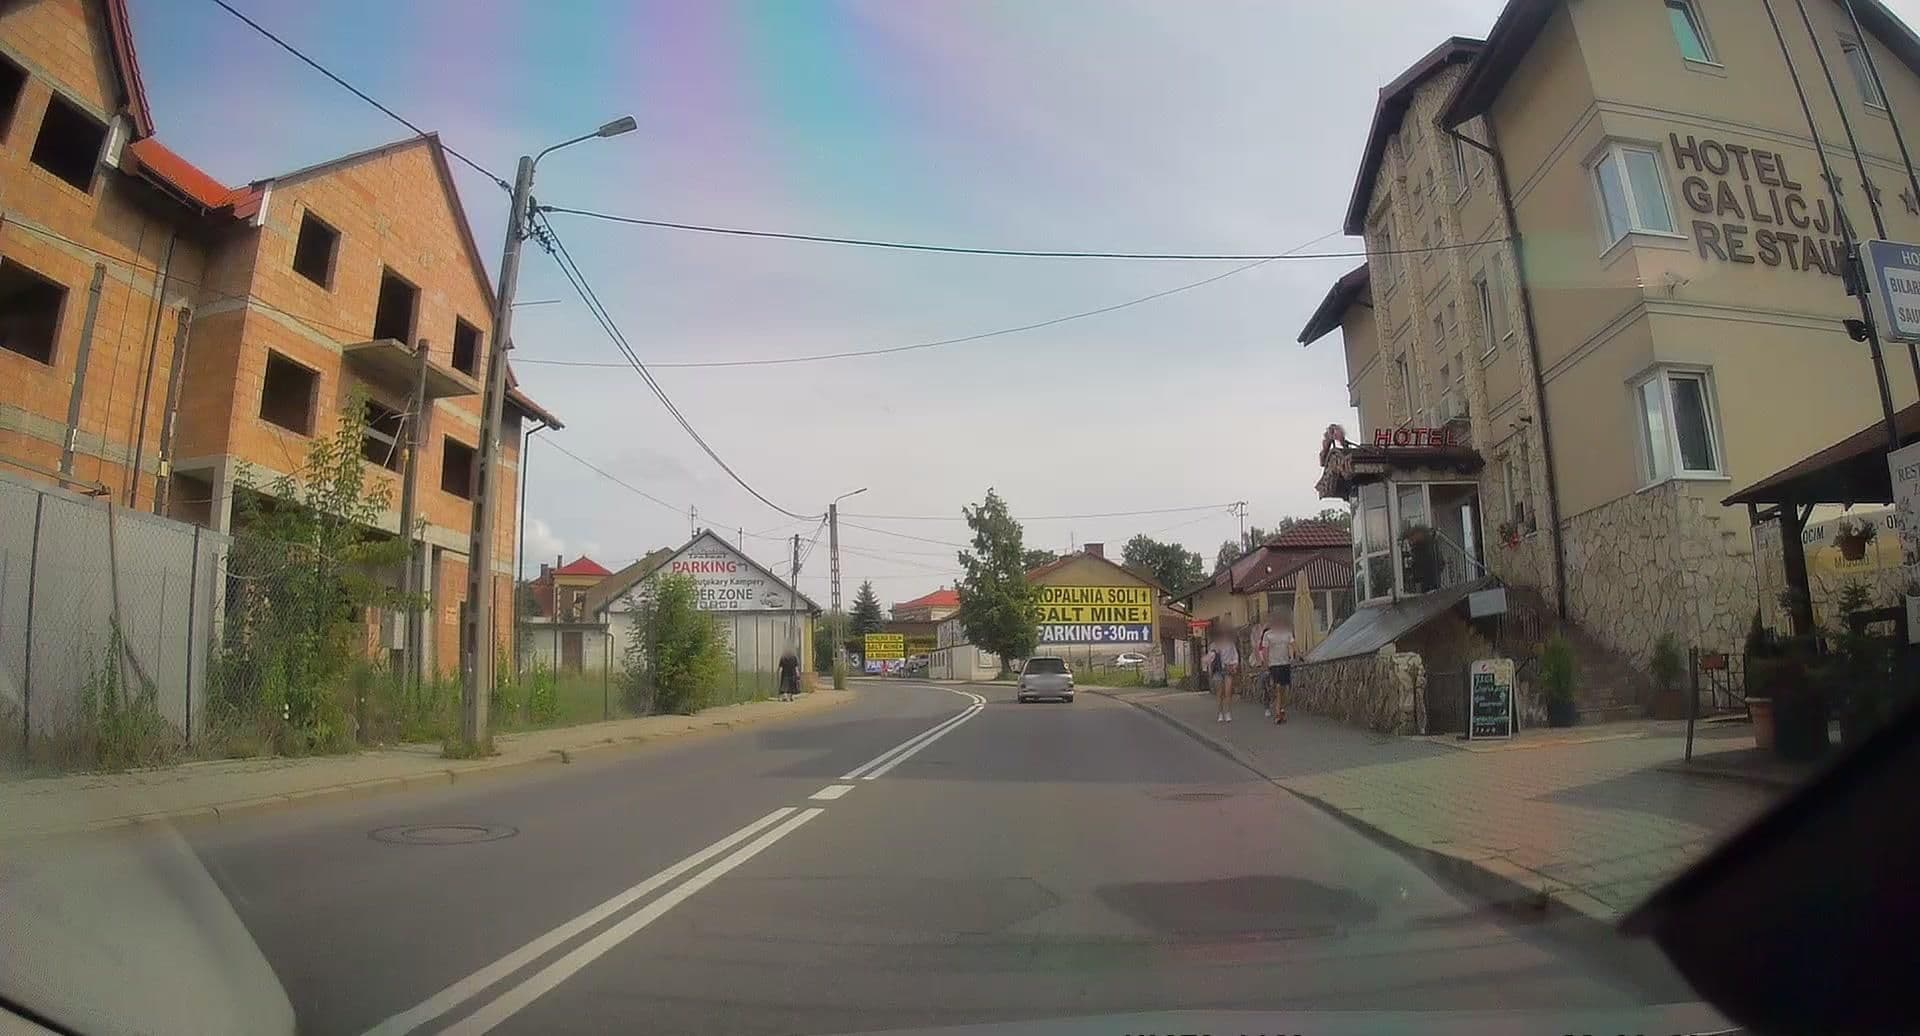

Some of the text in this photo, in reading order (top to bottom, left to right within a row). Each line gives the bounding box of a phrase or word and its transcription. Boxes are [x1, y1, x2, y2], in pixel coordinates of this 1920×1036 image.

[1669, 132, 1802, 191] HOTEL
[1901, 250, 1920, 266] HO
[1375, 427, 1458, 448] HOTEL
[672, 560, 737, 574] PARKING
[719, 589, 752, 601] ZONE
[1108, 588, 1138, 604] SOLI
[1038, 607, 1139, 622] SALT MINE
